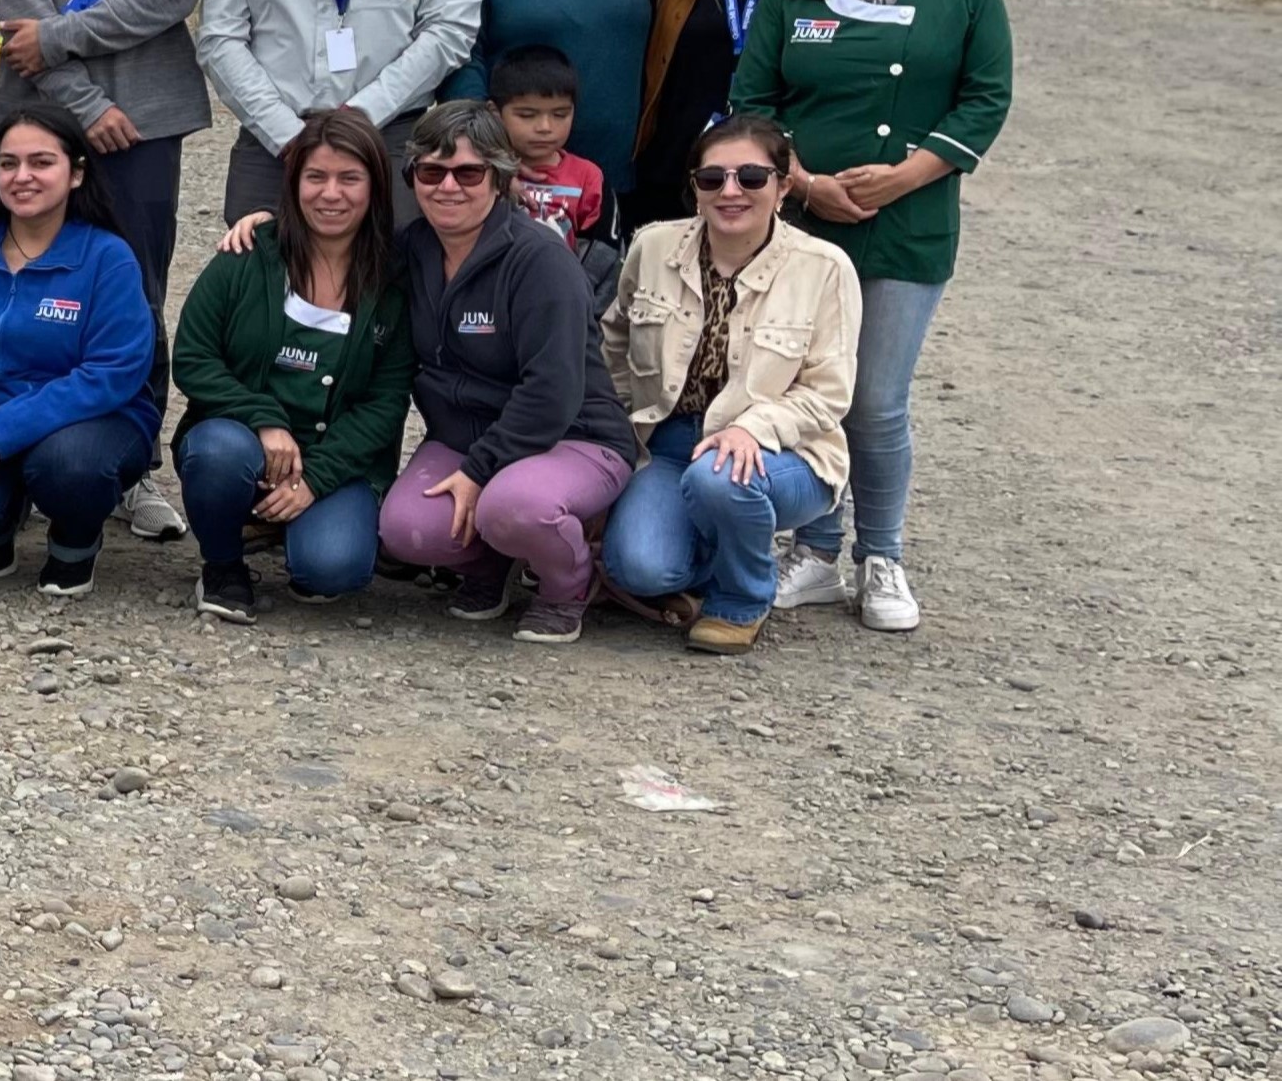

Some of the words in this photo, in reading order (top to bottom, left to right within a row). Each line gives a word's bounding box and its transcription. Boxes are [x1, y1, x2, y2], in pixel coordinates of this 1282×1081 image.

[791, 27, 836, 39] JUNJI
[35, 306, 78, 322] JUNJI
[278, 346, 318, 363] JUNJI
